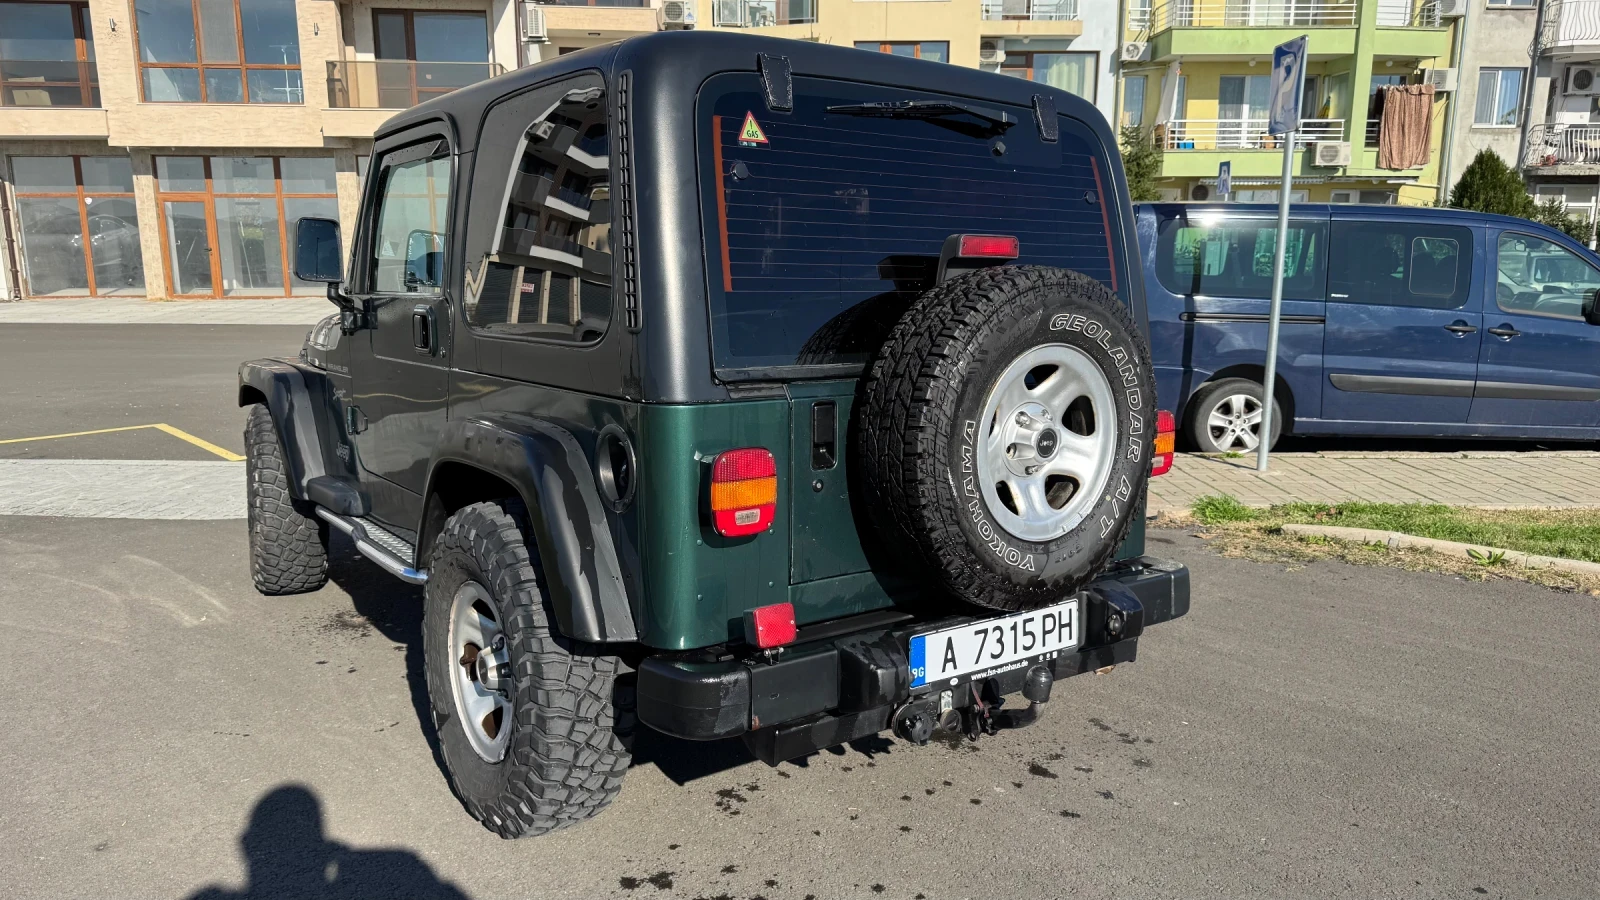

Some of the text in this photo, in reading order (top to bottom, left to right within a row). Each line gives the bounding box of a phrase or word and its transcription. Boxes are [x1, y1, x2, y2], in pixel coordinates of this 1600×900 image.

[746, 129, 759, 138] GAS
[1049, 313, 1142, 463] GEOLANDAR
[1100, 474, 1132, 539] A/T
[962, 420, 1036, 572] YOKOHAMA
[941, 608, 1073, 673] A 7315 PH
